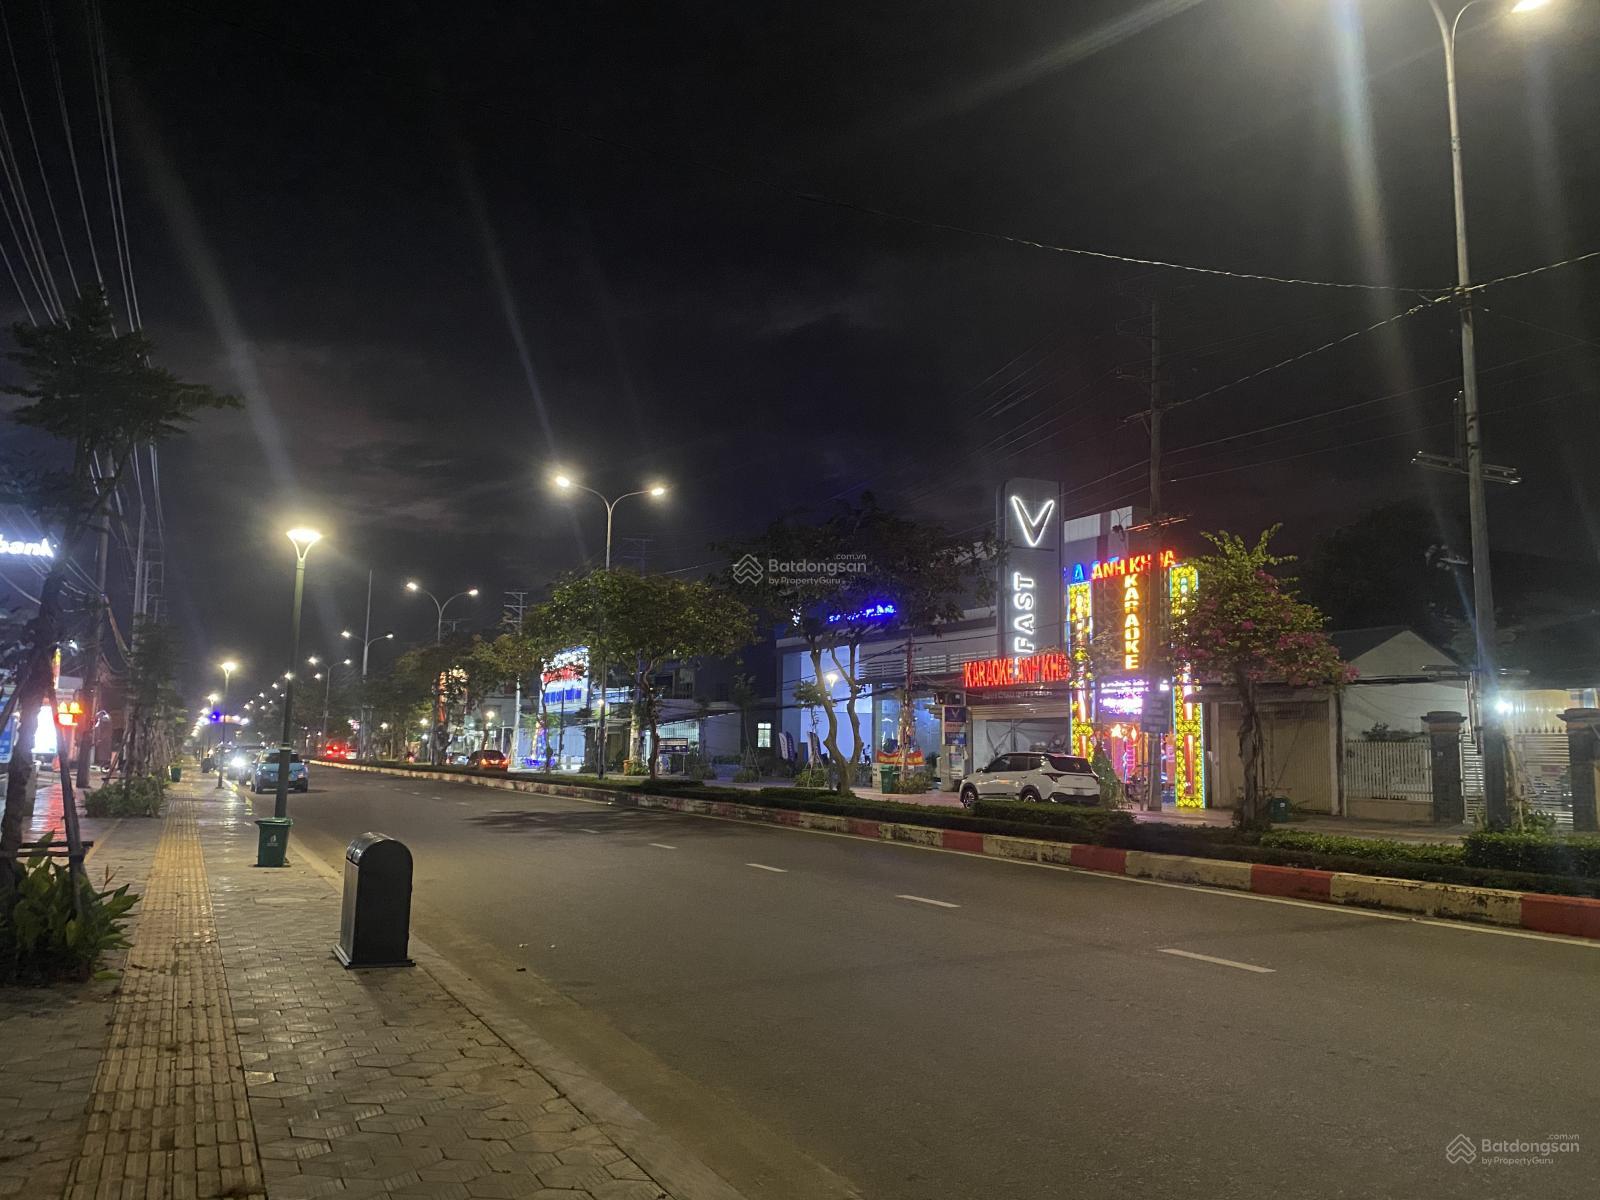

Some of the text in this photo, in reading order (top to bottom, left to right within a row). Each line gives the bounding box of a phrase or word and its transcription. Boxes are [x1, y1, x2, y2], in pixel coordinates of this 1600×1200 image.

[1092, 550, 1176, 580] ANH KHA
[1124, 573, 1140, 670] KARAOKE
[964, 658, 1014, 688] KARAOKE
[1015, 655, 1040, 684] ANH
